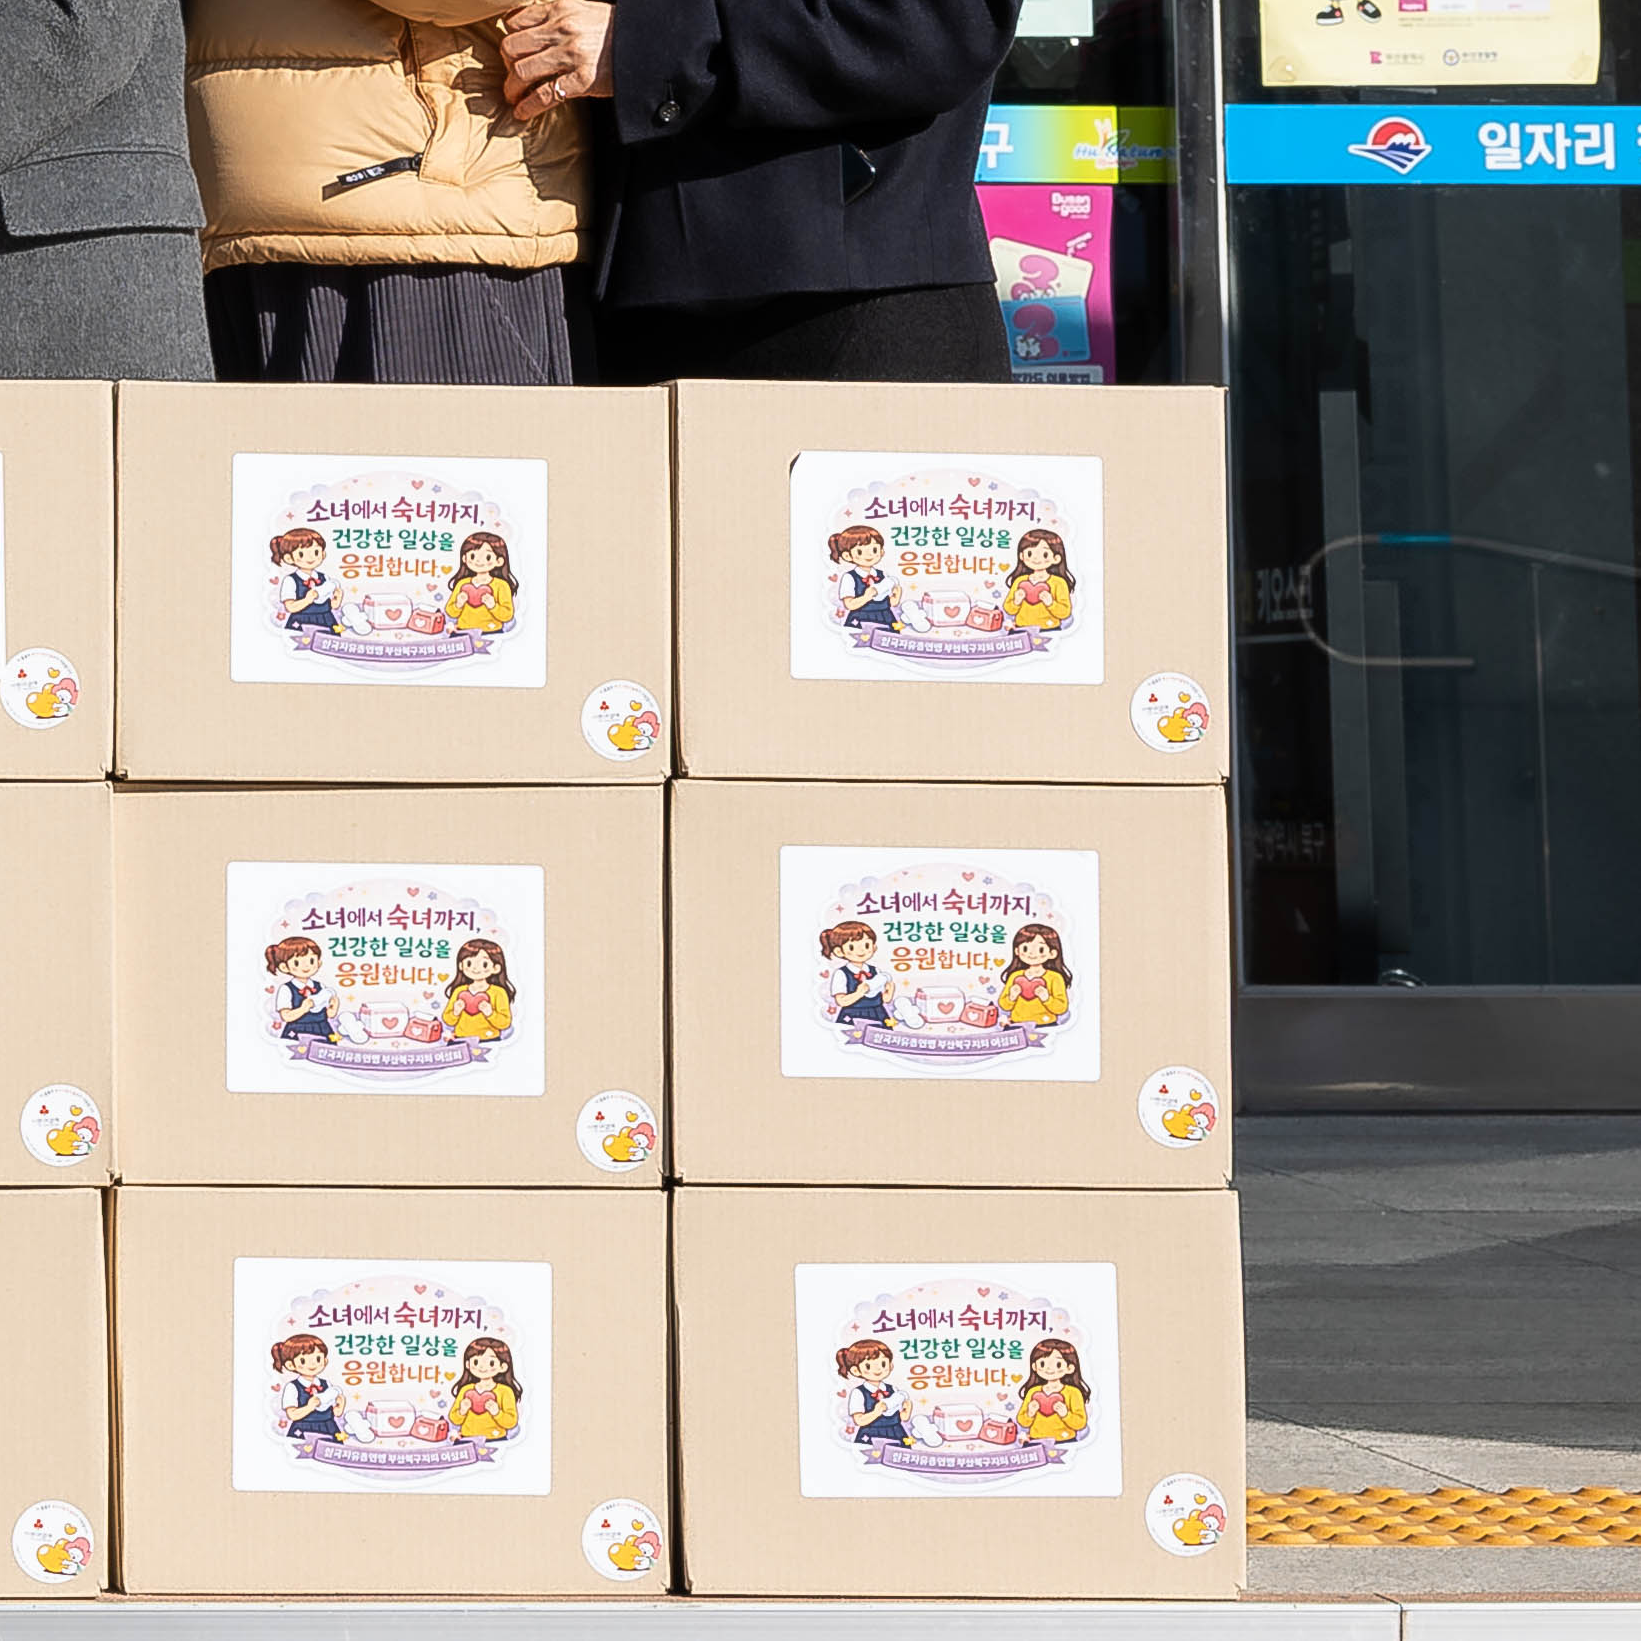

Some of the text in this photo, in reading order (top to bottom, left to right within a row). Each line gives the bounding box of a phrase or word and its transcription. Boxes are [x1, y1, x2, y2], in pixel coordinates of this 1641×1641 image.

[1478, 123, 1616, 171] 일자리
[306, 498, 387, 523] 소녀에서
[864, 495, 944, 520] 소녀에서
[332, 528, 455, 552] 건강한 일상을
[890, 525, 1012, 549] 건강한 일상을
[856, 891, 938, 916] 소녀에서
[882, 921, 1007, 944] 건강한 일상을
[307, 1303, 389, 1329] 소녀에서
[871, 1308, 954, 1334] 소녀에서
[334, 1334, 458, 1358] 건강한 일상을
[899, 1337, 1024, 1360] 건강한 일상을
